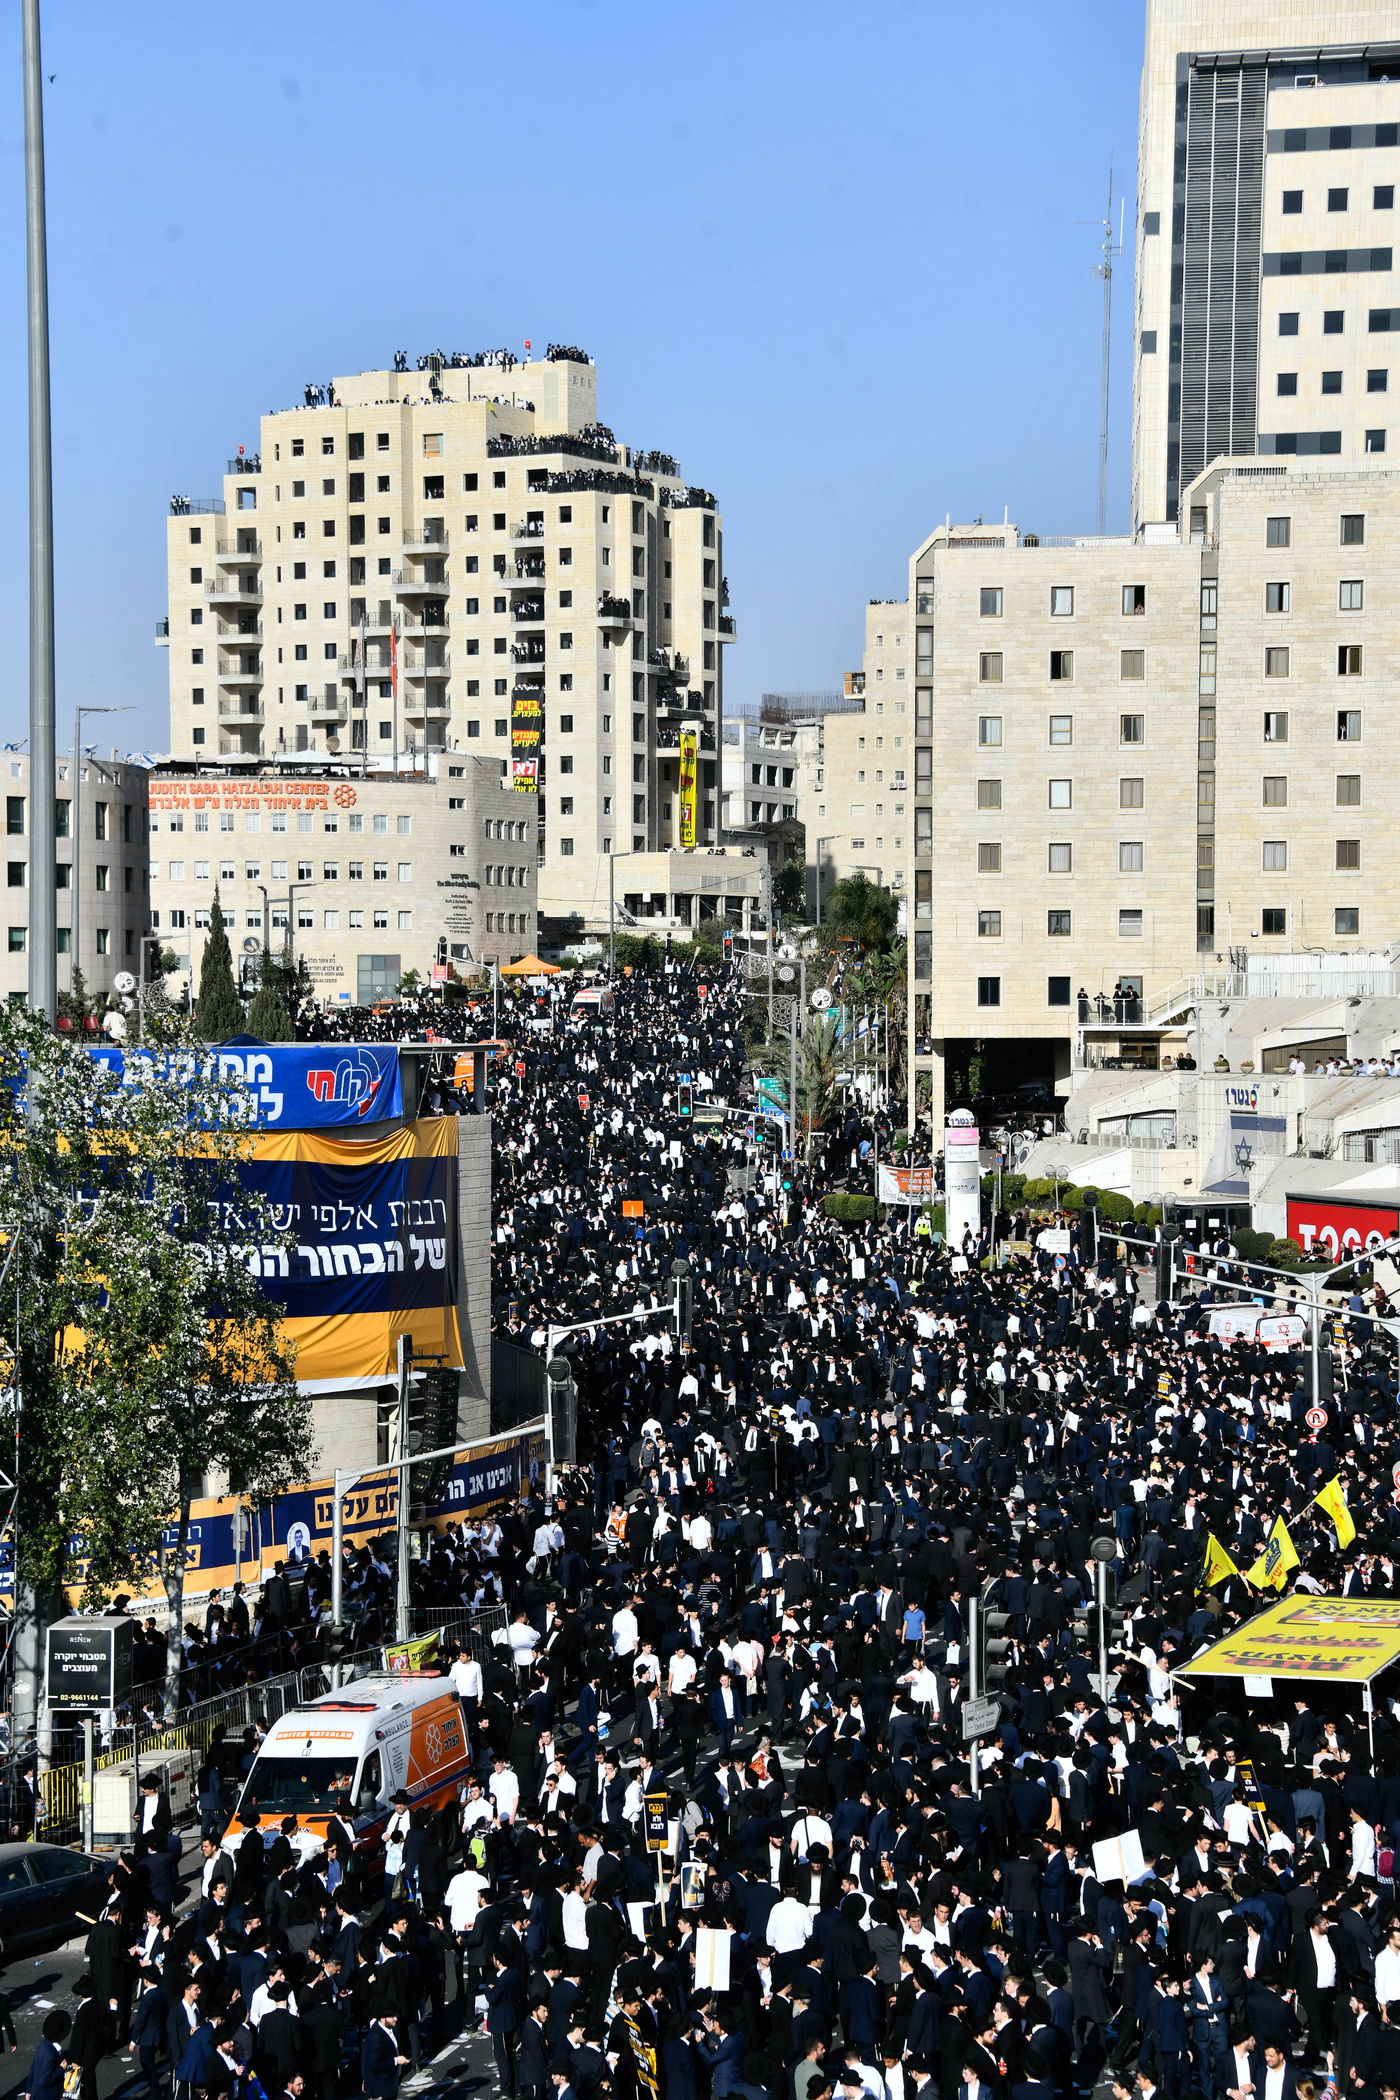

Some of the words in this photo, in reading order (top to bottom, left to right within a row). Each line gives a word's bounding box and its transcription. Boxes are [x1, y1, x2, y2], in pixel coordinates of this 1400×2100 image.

[189, 783, 219, 795] SABA
[222, 783, 283, 795] HATZALAH
[284, 783, 329, 795] CENTER
[224, 796, 260, 810] הצלה
[264, 797, 301, 810] איחוד
[305, 797, 329, 810] בית
[311, 1199, 378, 1232] אלפי
[390, 1198, 447, 1227] רבבות
[298, 1240, 405, 1278] הבחור
[409, 1233, 447, 1271] של
[469, 1474, 484, 1495] אב
[486, 1464, 513, 1490] אבינו
[54, 1653, 77, 1662] יוקרה
[79, 1652, 107, 1660] מטבחי
[62, 1664, 98, 1672] מעוצבים
[441, 1717, 457, 1734] איחוד
